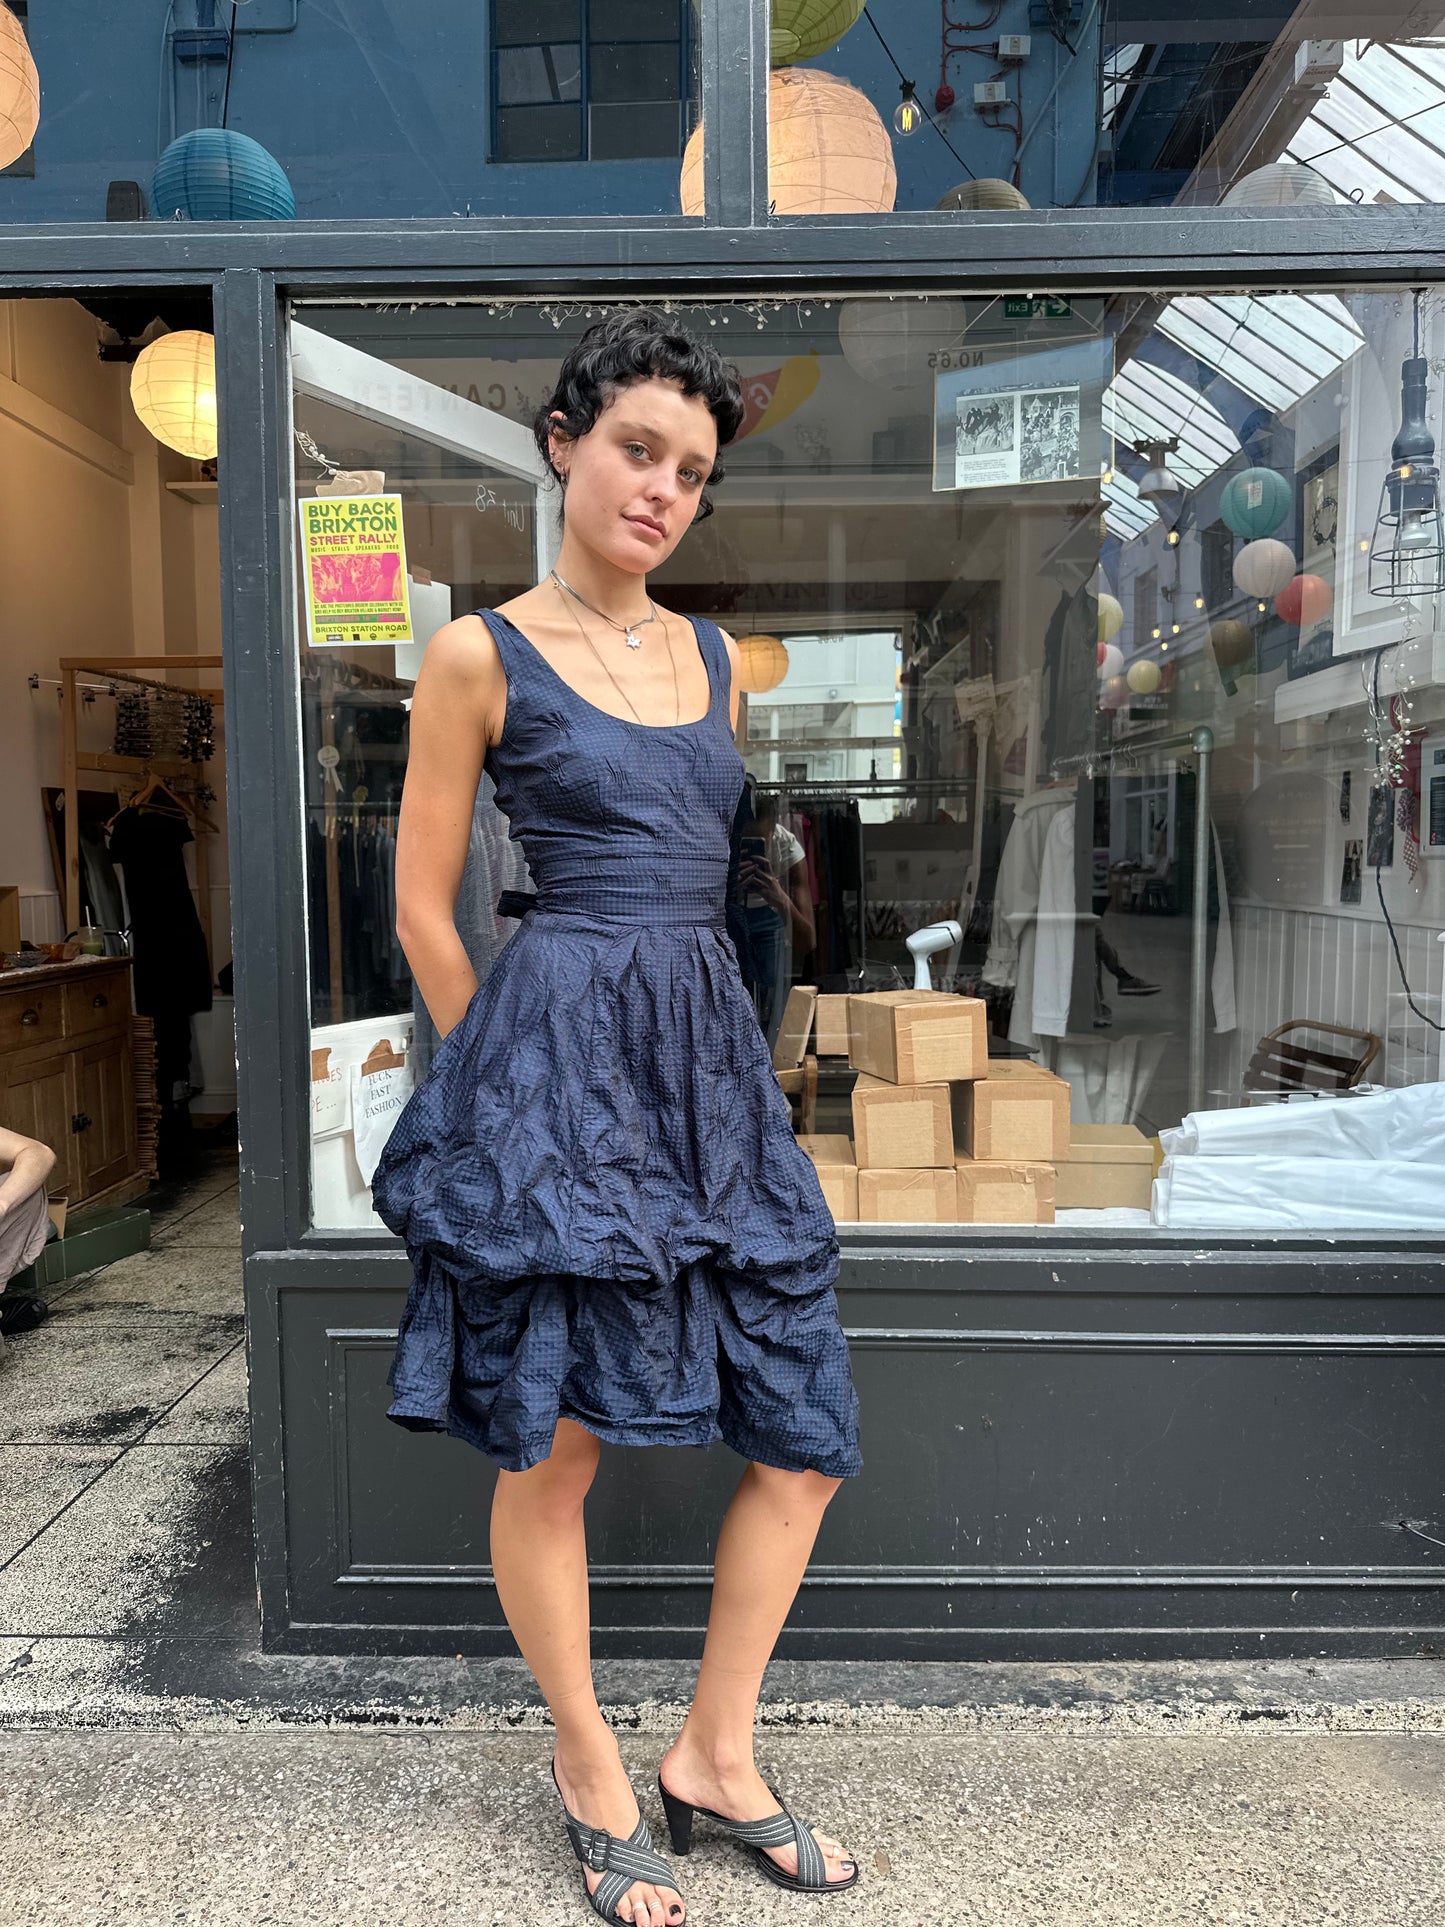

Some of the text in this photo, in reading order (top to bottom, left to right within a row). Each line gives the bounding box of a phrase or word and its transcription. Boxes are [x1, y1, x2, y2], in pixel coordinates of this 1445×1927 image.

[308, 502, 396, 518] BUY BACK
[310, 516, 398, 534] BRIXTON
[310, 533, 396, 546] STREET RALLY
[370, 1084, 391, 1100] FAST
[365, 1097, 402, 1118] FASHION
